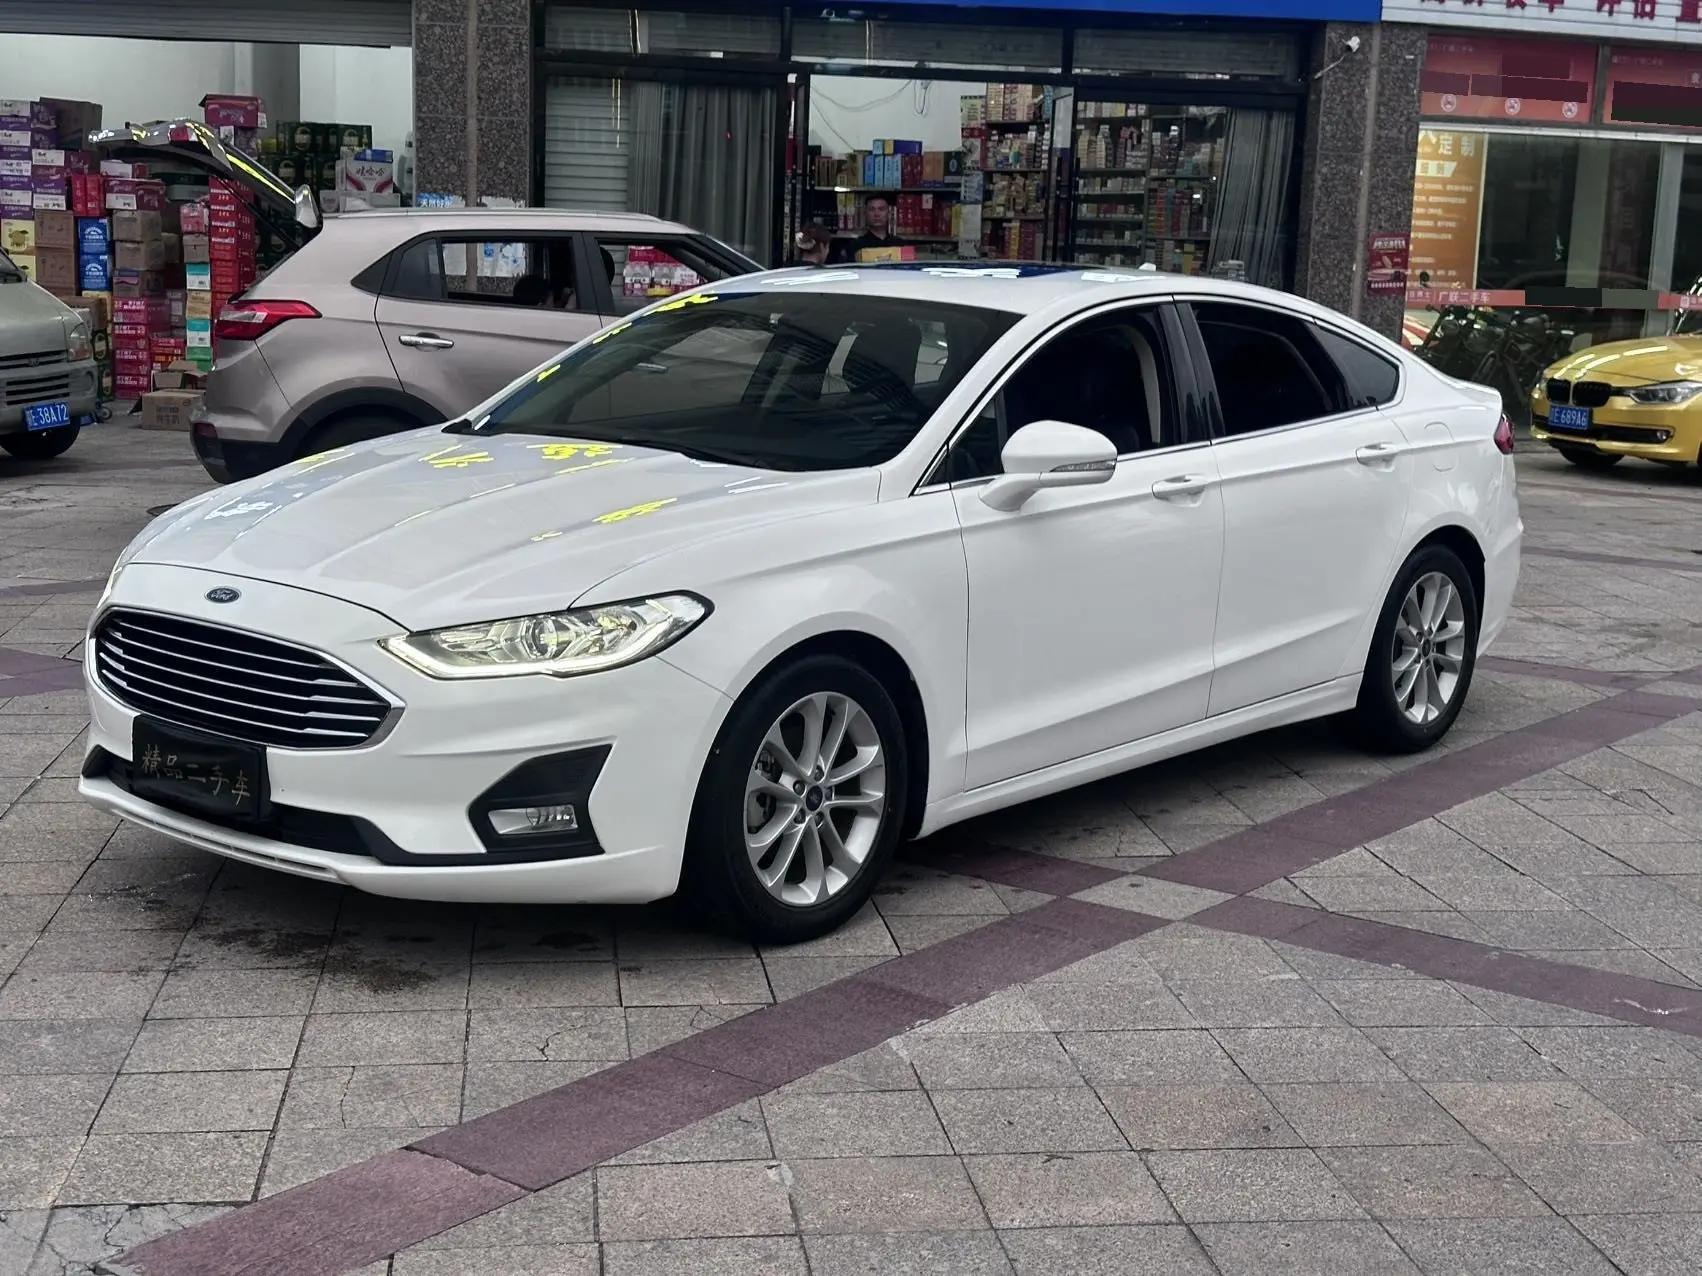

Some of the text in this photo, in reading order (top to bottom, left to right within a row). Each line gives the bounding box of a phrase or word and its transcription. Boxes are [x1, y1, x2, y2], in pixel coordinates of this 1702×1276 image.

[25, 404, 69, 426] E38A72
[142, 744, 250, 808] 精品二手车
